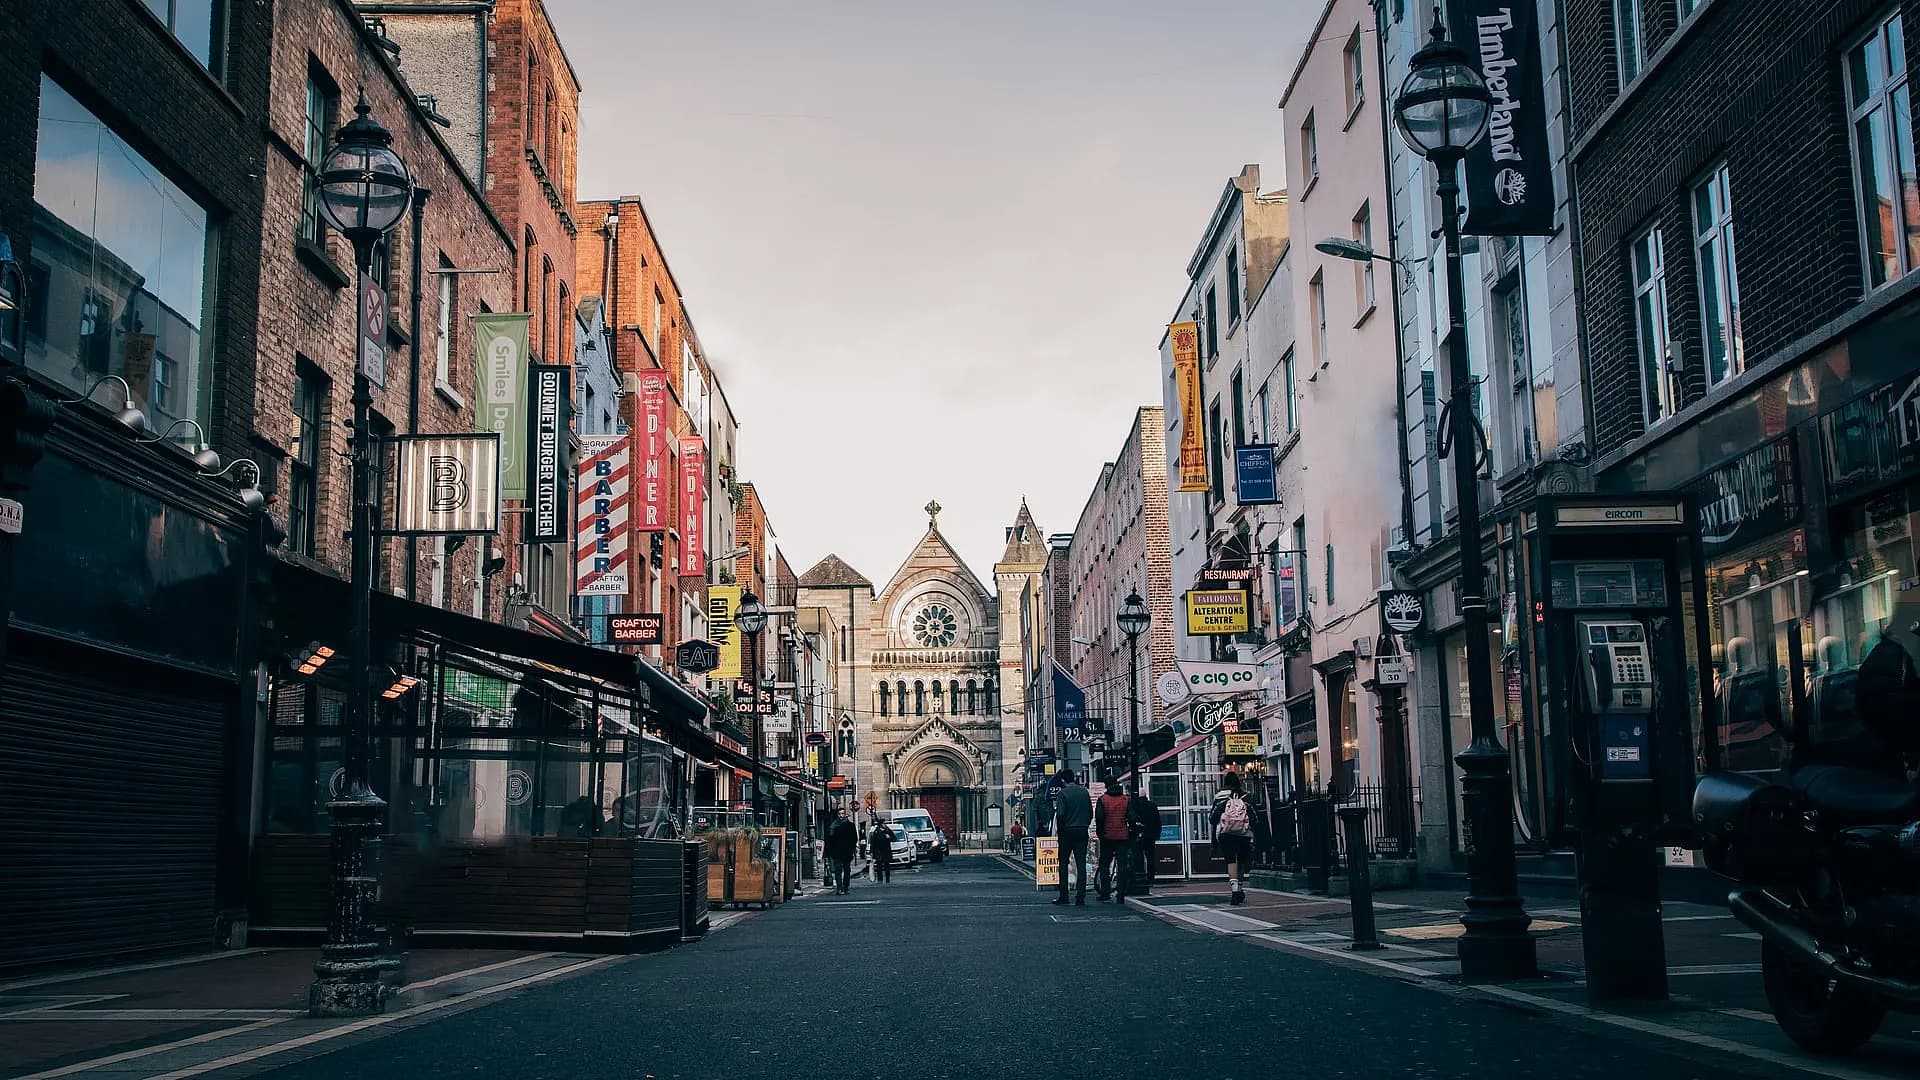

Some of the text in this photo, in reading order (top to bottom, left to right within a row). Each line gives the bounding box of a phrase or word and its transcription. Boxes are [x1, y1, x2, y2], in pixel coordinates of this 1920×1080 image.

[1477, 8, 1523, 161] Timberland
[494, 345, 510, 398] Smiles
[589, 440, 625, 448] GRAFTON
[539, 372, 556, 537] GOURMET BURGER KITCHEN
[646, 414, 658, 525] DINER
[429, 455, 469, 512] B
[594, 460, 613, 573] BARBER
[1605, 509, 1643, 518] eircom
[686, 475, 697, 571] DINER
[1204, 569, 1250, 580] RESTAURANT
[588, 583, 621, 591] BARBER
[1197, 593, 1240, 603] TAILORING
[1194, 606, 1245, 616] ALTERATIONS
[612, 619, 660, 629] GRAFTON
[1204, 616, 1234, 625] CENTRE
[615, 629, 656, 639] BARBER
[679, 647, 716, 667] EAT
[1190, 670, 1253, 686] e cig co
[1065, 727, 1081, 741] 22
[1038, 857, 1059, 865] ALTERAT
